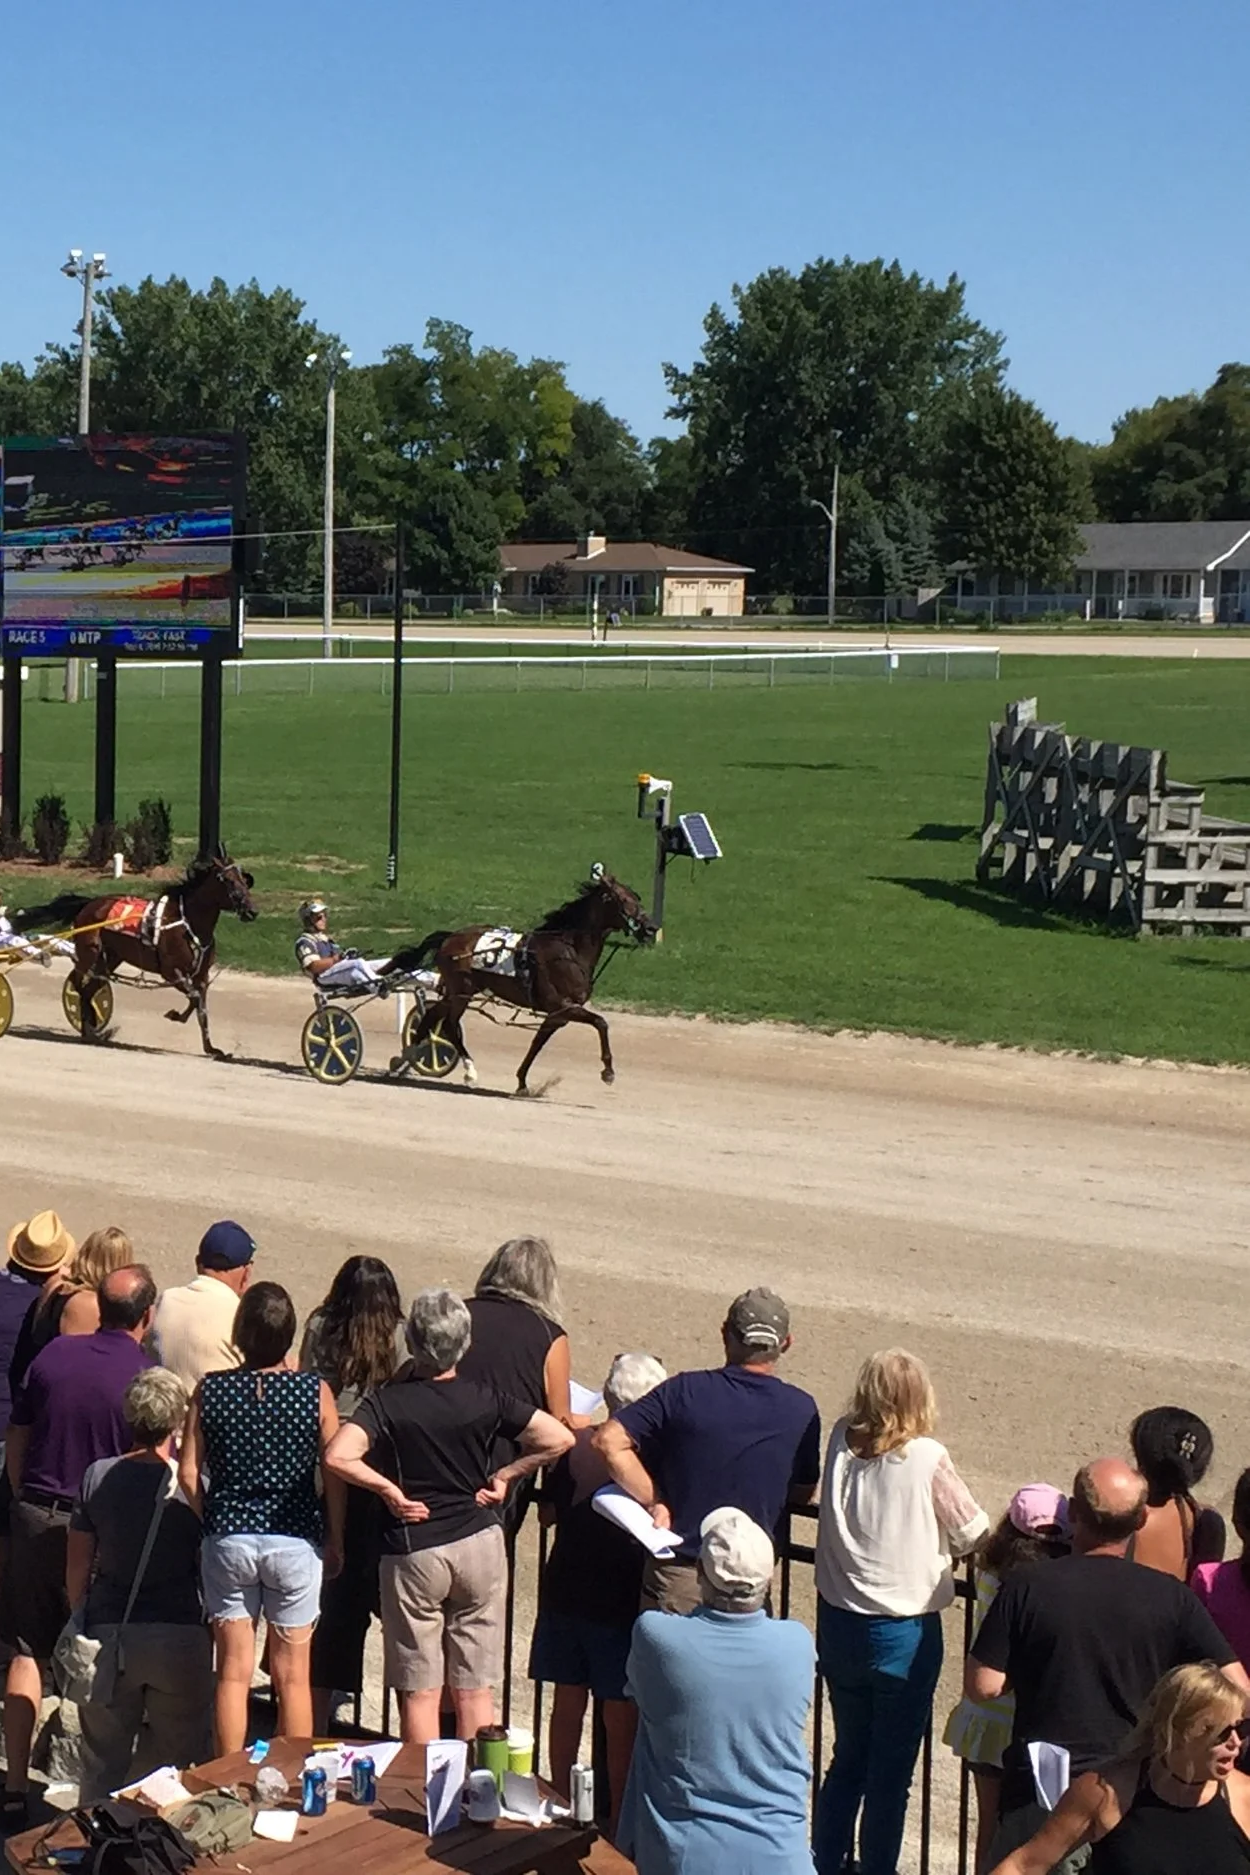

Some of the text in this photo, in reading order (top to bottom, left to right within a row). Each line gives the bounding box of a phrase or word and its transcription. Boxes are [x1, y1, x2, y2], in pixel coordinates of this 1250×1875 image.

[8, 630, 38, 643] RACE
[77, 631, 101, 644] MTP
[592, 862, 604, 881] 3
